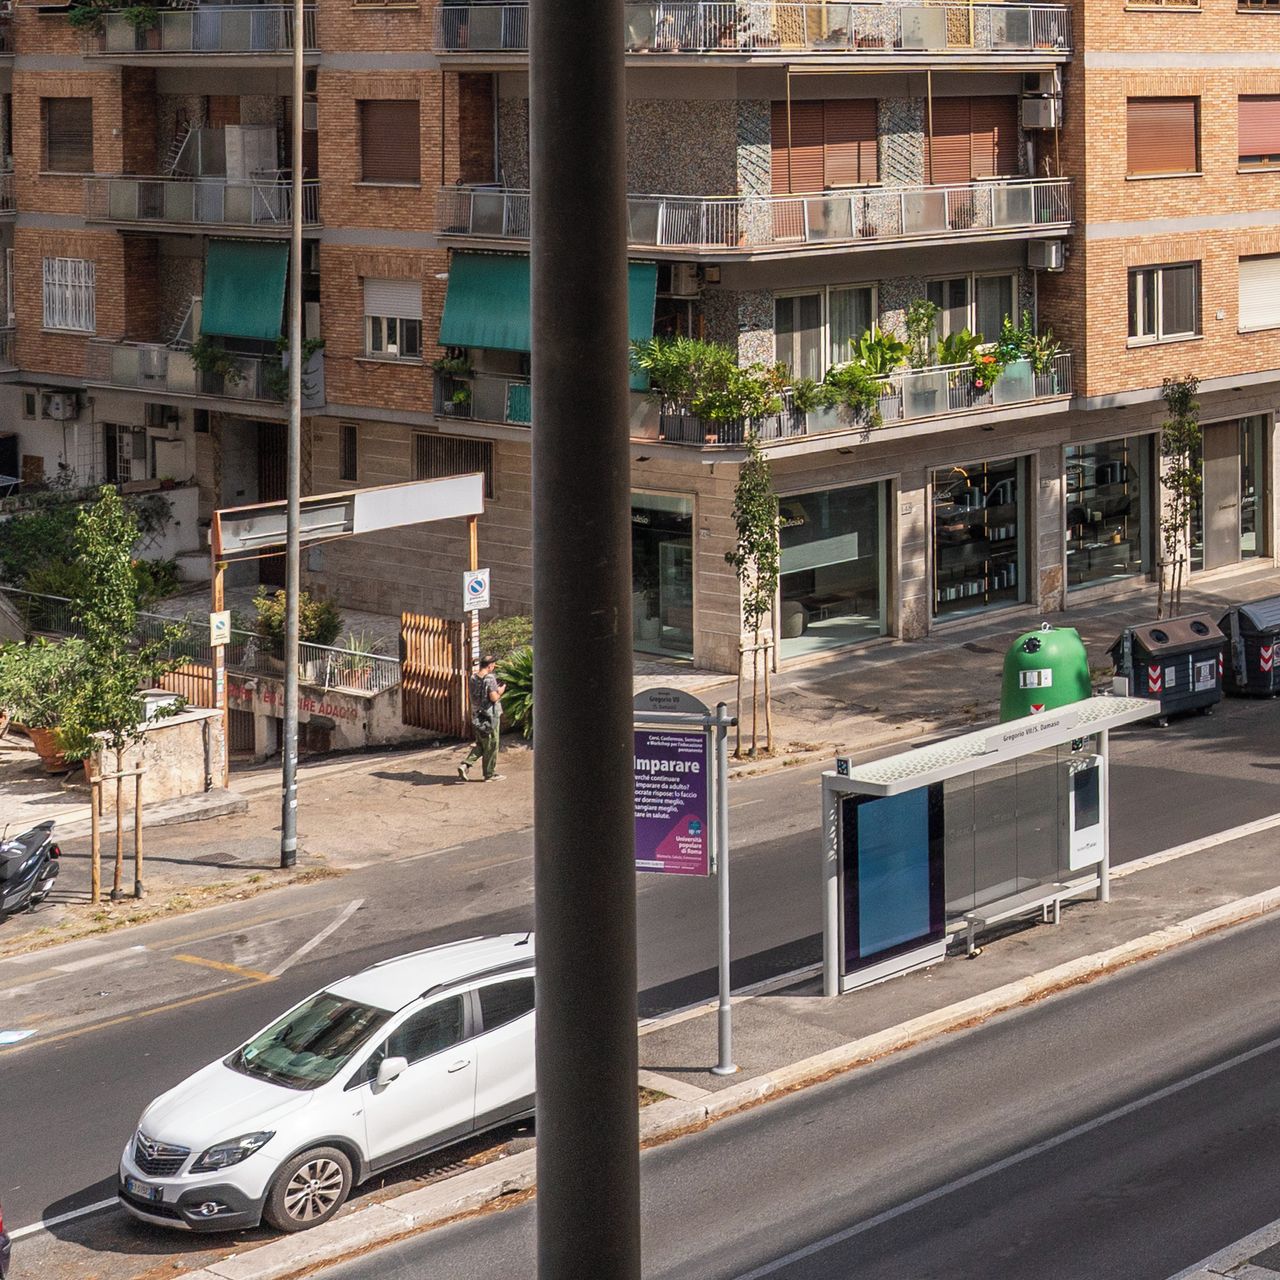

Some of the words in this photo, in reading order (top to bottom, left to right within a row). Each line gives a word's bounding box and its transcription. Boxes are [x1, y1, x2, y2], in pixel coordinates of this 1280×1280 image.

[1003, 731, 1025, 741] Gregorio
[1040, 721, 1060, 731] Damaso
[635, 781, 661, 789] imparare
[664, 798, 685, 806] meglio,
[657, 805, 679, 813] meglio,
